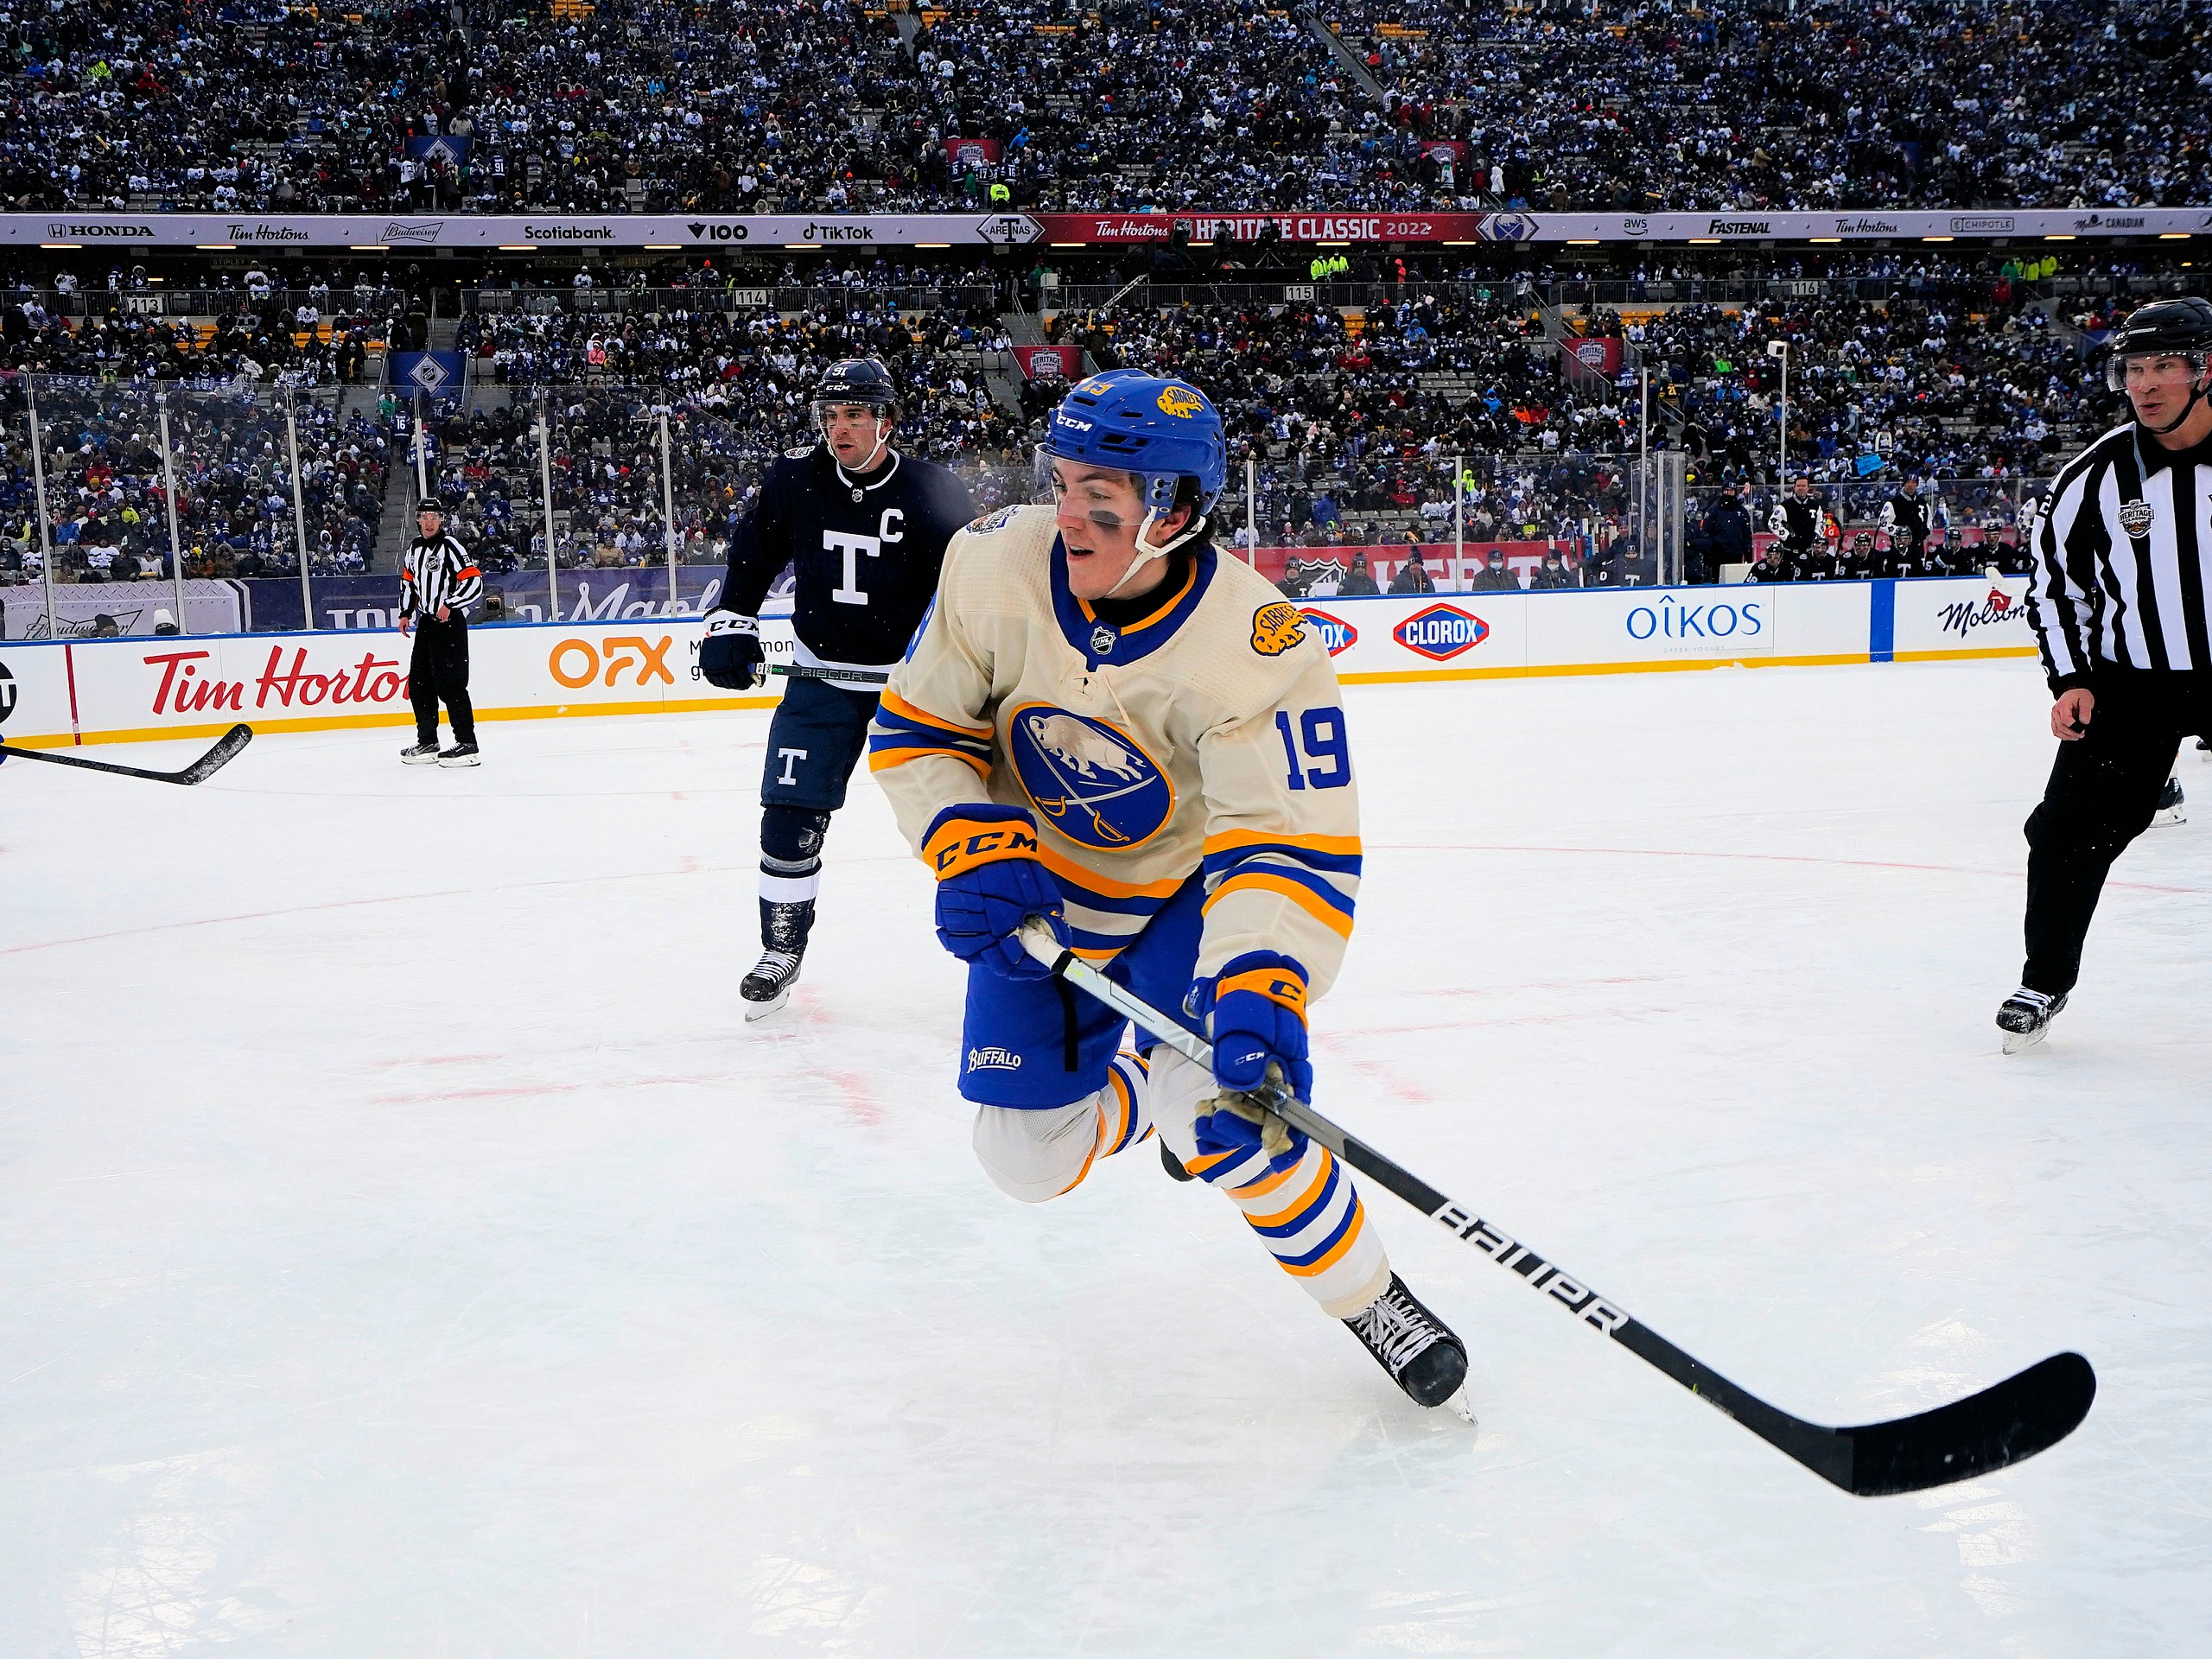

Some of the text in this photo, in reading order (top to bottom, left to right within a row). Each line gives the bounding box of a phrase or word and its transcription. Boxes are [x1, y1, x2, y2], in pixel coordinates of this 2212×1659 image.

[68, 226, 156, 237] HONDA
[386, 226, 437, 238] Budweiser
[1095, 221, 1119, 237] Tim
[1120, 220, 1168, 237] Hortons
[1298, 219, 1381, 239] CLASSIC
[1386, 222, 1430, 236] 2022
[1624, 219, 1648, 229] aws
[1707, 219, 1771, 234] FASTENAL
[1835, 218, 1897, 232] Tim Hortons
[226, 224, 308, 241] Tim Hortons
[524, 226, 613, 239] Scotiabank
[709, 225, 748, 240] 100
[819, 226, 874, 240] TikTok
[1287, 286, 1311, 299] 115
[1794, 282, 1815, 294] 116
[131, 298, 159, 312] 113
[737, 290, 764, 304] 114
[1031, 355, 1061, 365] HERITAGE
[1166, 389, 1198, 405] SABRES
[1055, 414, 1093, 432] CCM
[2119, 509, 2153, 522] HERITAGE
[879, 508, 904, 543] C
[823, 529, 881, 606] T
[1259, 605, 1296, 637] SABRES
[1937, 601, 2026, 639] Molson
[1405, 620, 1478, 645] CLOROX
[1094, 636, 1111, 648] NHL
[143, 645, 411, 715] Tim Horto
[1275, 706, 1351, 791] 19
[778, 748, 808, 785] T
[935, 831, 1038, 872] CCM
[967, 1046, 1022, 1074] BUFFALO
[1430, 1199, 1631, 1336] BAUER
